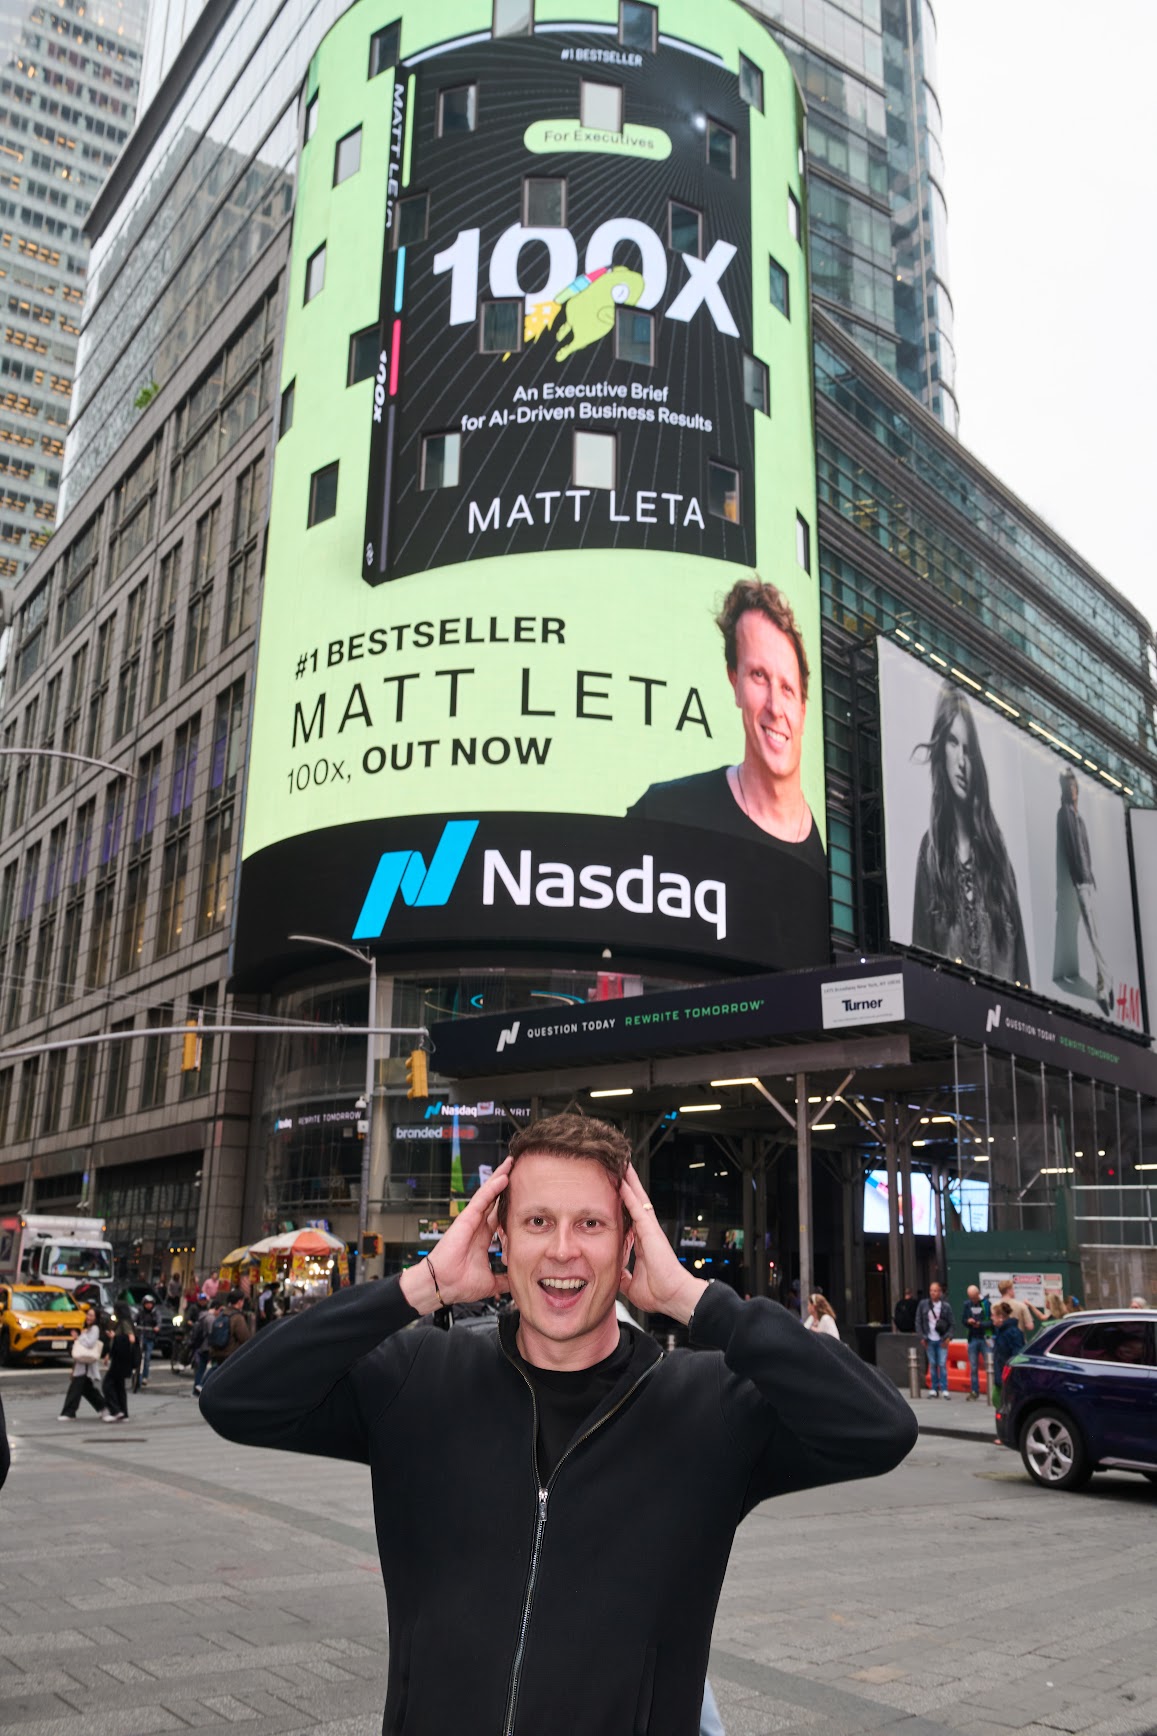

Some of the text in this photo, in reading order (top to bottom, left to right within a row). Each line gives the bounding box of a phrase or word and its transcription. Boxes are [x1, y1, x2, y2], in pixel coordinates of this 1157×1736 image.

[561, 49, 643, 67] #1 BESTSELLER
[391, 83, 405, 160] MATT
[544, 130, 655, 150] For Executives
[433, 217, 740, 338] 100x
[513, 381, 669, 402] An Executive Brief
[461, 402, 712, 432] for AI-Driven Business Results
[468, 490, 705, 534] MATT LETA
[295, 616, 566, 680] #1 BESTSELLER
[291, 667, 713, 748] MATT LETA
[287, 736, 552, 794] 100x, OUT NOW
[482, 849, 727, 940] Nasdaq
[842, 999, 883, 1012] Turner
[527, 1023, 577, 1038] QUESTION
[582, 1018, 616, 1031] TODAY
[625, 1010, 680, 1027] REWRITE
[1005, 1017, 1036, 1035] QUESTION
[1037, 1029, 1056, 1041] TODAY
[322, 1111, 361, 1122] TOMORROW
[441, 1104, 477, 1118] Nasdaq
